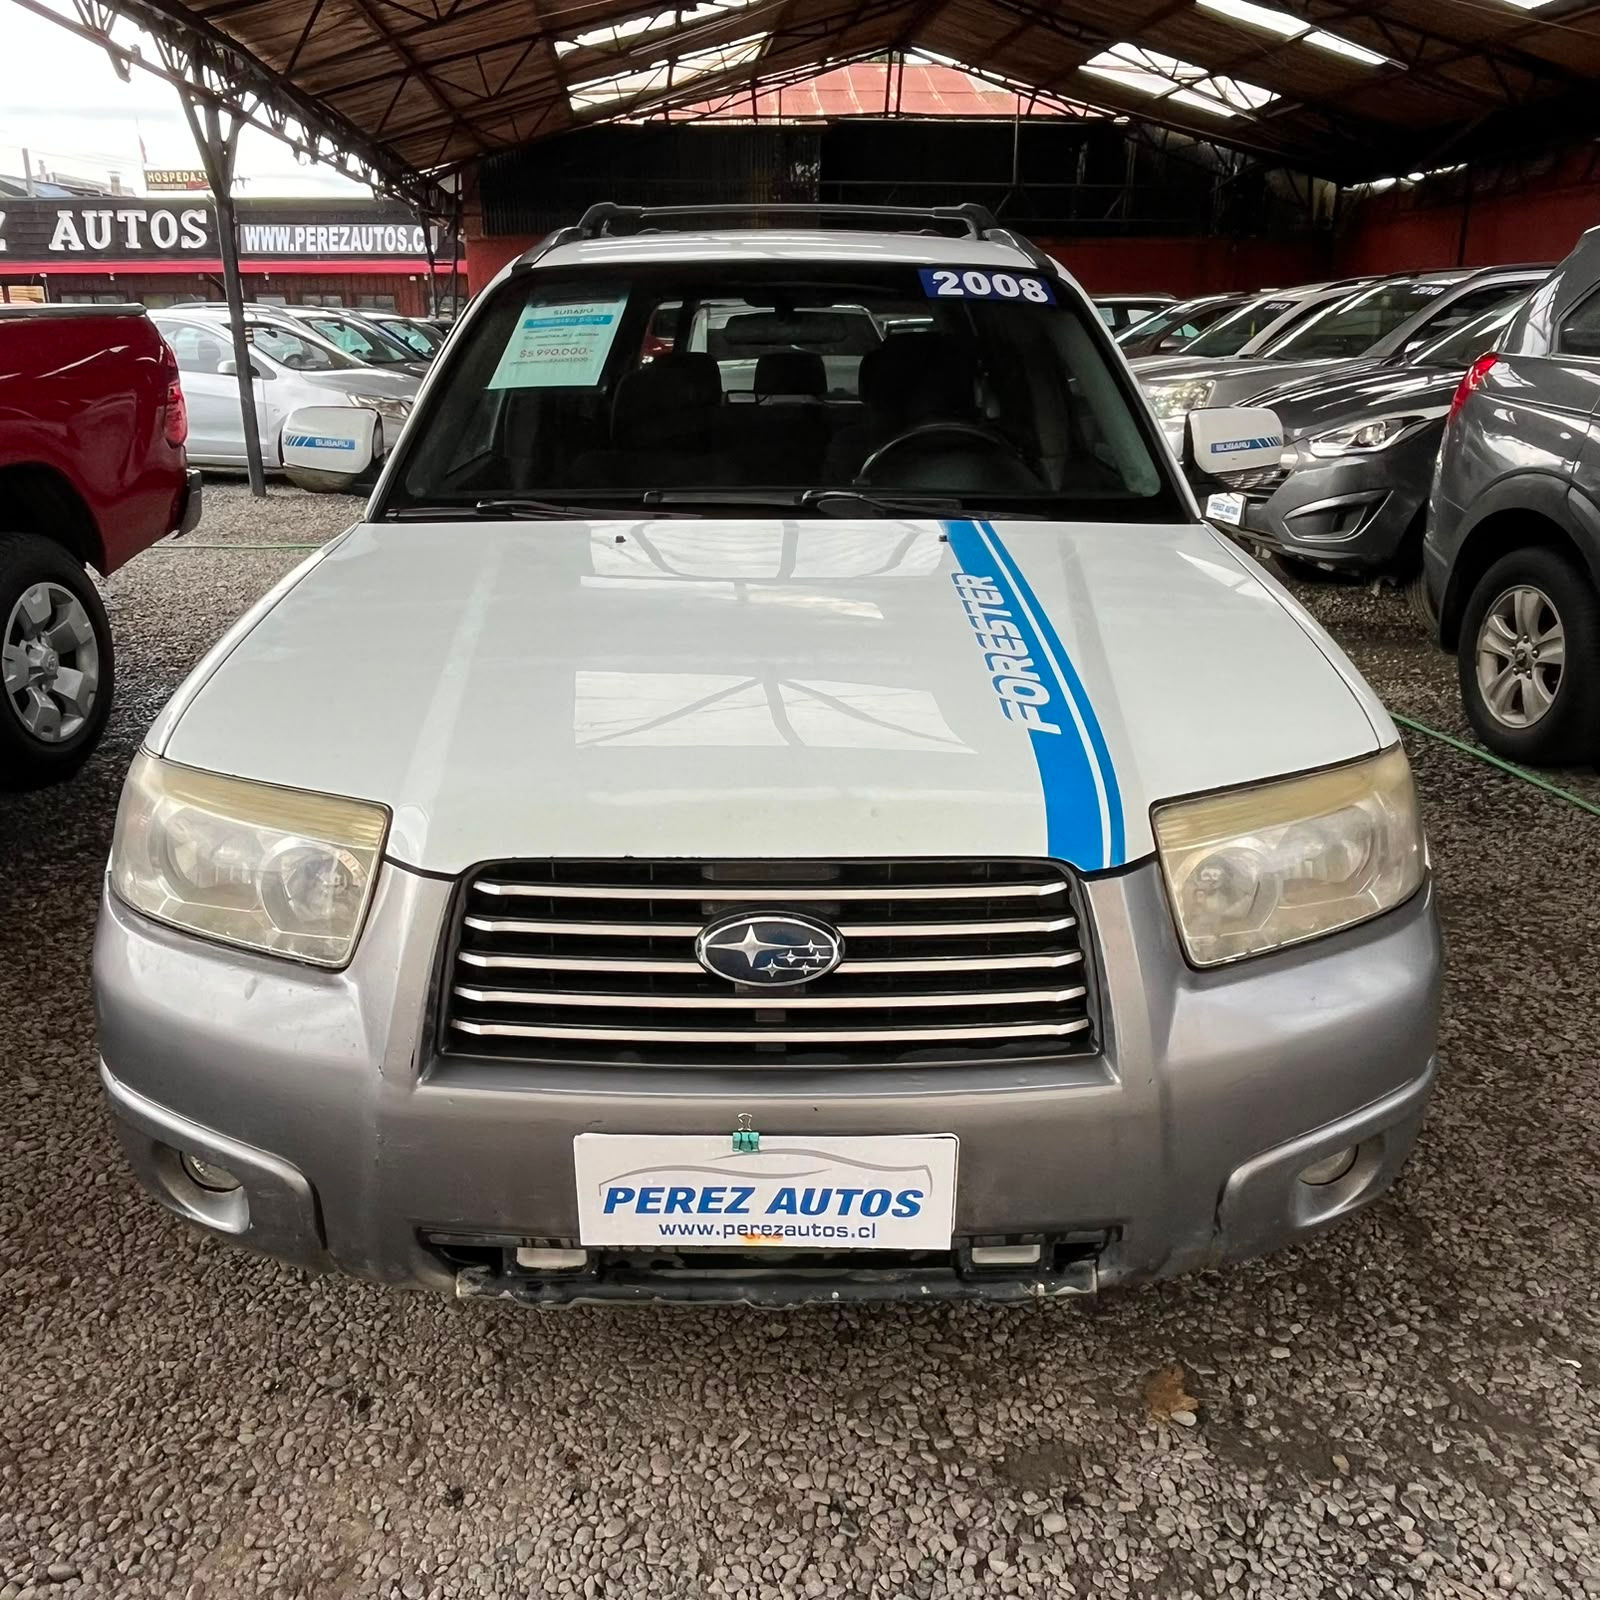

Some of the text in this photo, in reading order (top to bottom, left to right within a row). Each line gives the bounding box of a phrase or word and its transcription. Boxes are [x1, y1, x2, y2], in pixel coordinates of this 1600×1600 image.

[48, 209, 208, 251] AUTOS
[244, 225, 436, 253] WWW.PEREZAUTOS.C
[932, 271, 1049, 303] 2008
[315, 438, 350, 448] SUBARU
[1215, 441, 1251, 452] SUBARU
[951, 573, 1062, 735] FORESTER
[603, 1186, 925, 1218] PEREZ AUTOS
[658, 1221, 876, 1239] www.perezautos.cl
